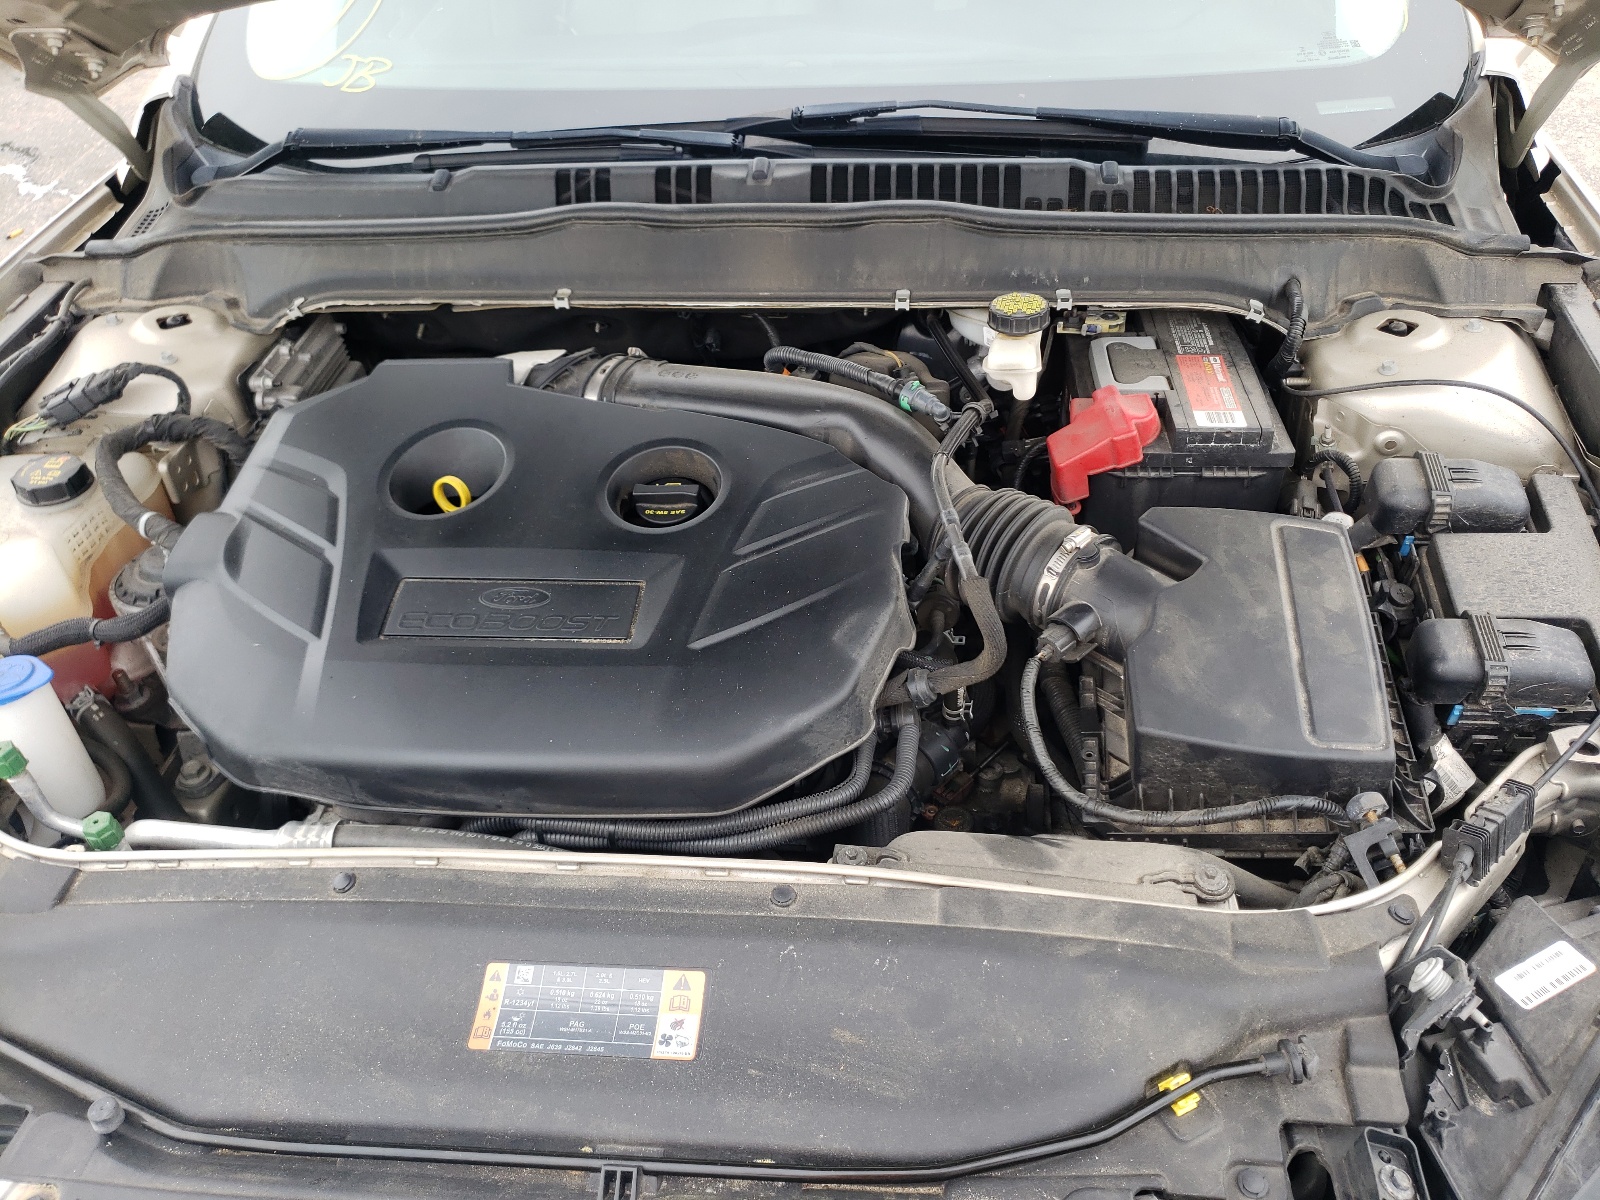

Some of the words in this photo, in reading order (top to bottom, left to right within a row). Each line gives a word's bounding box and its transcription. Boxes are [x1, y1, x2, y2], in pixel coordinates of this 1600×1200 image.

[607, 992, 614, 1000] kg
[647, 994, 654, 1002] kg
[504, 999, 535, 1007] R-1234yf
[497, 1040, 528, 1048] FoMoCo
